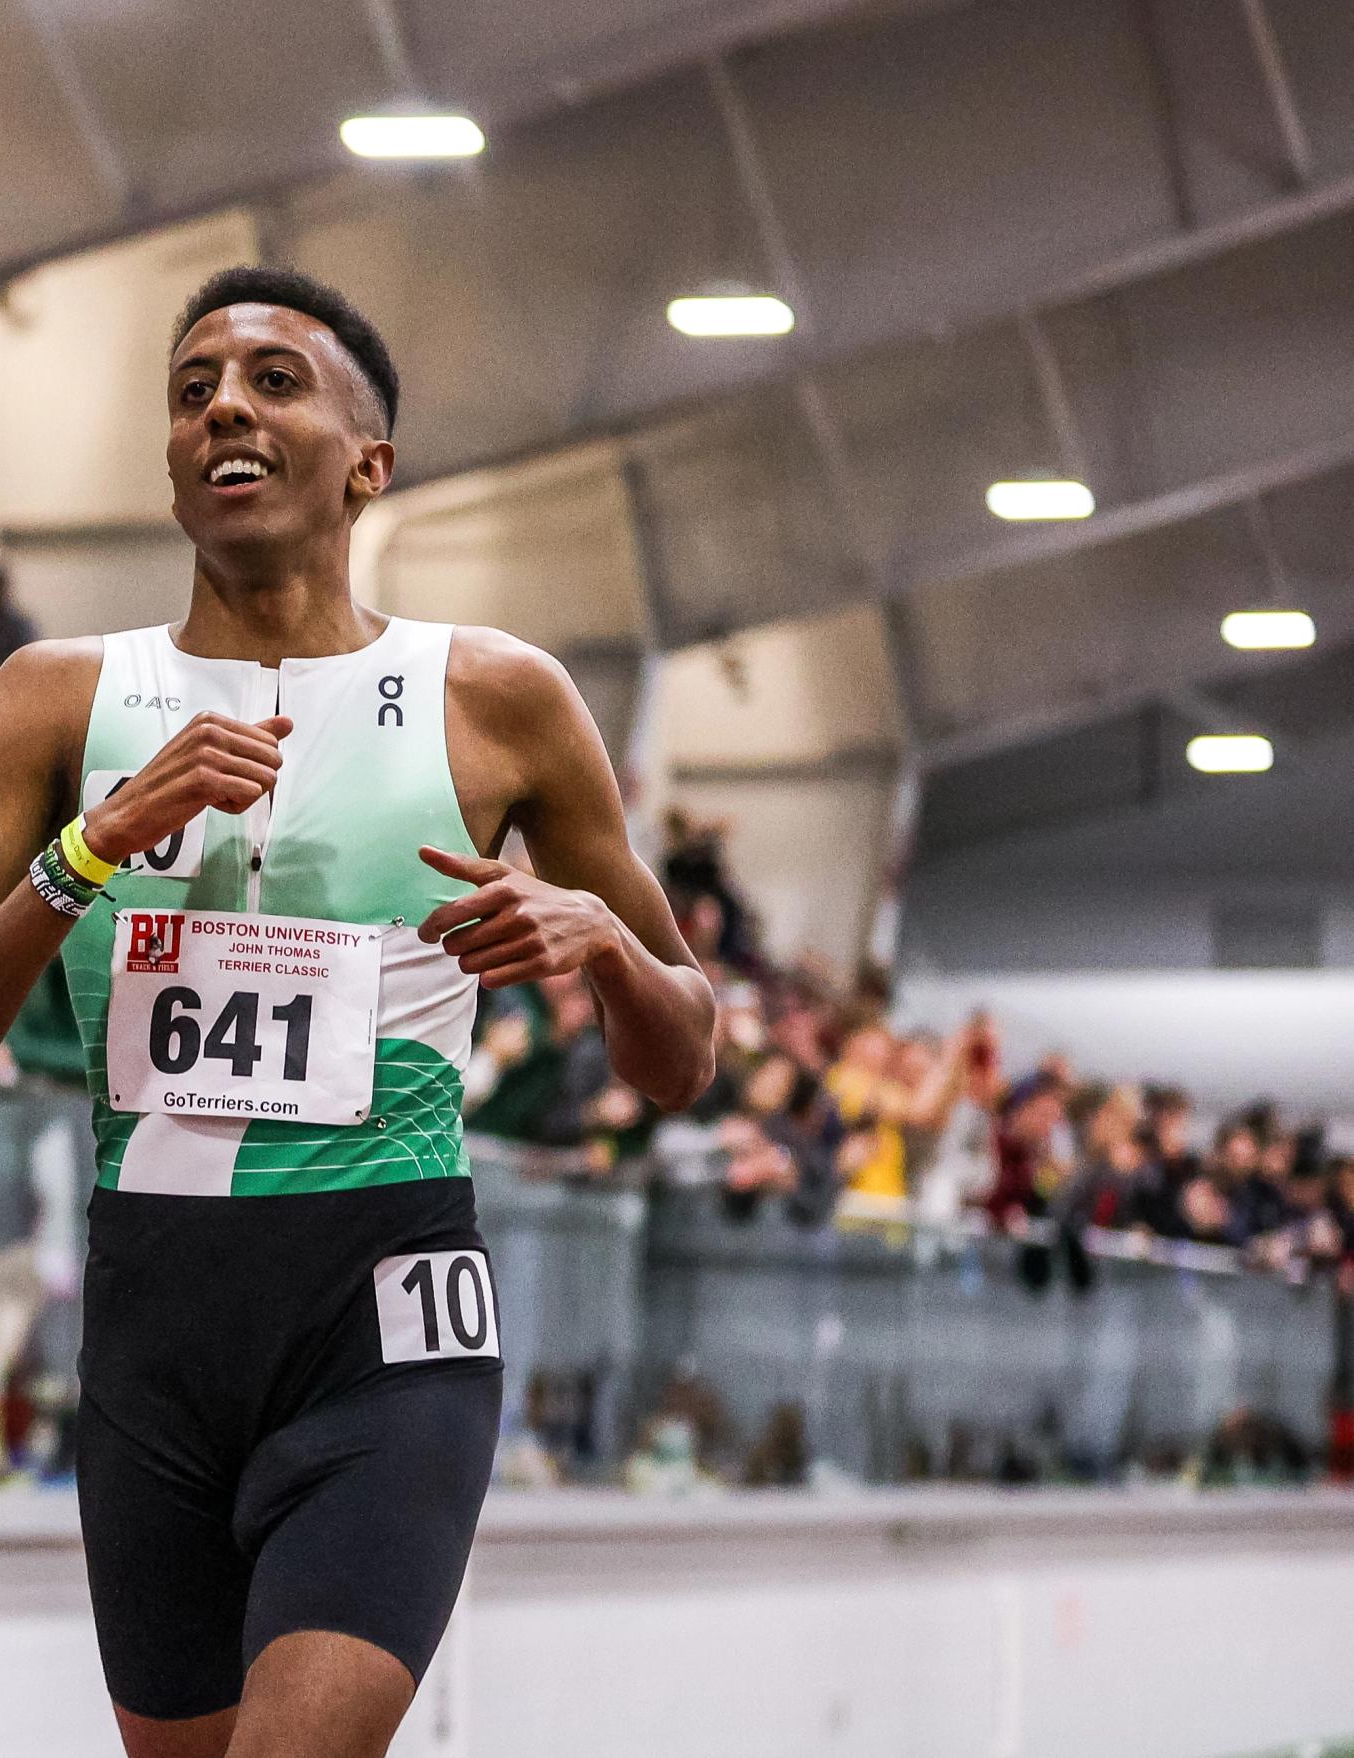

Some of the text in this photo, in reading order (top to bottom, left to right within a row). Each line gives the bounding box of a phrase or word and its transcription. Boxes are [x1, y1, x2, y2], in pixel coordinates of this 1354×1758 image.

[127, 914, 185, 962] BU
[192, 921, 361, 947] BOSTON UNIVERSITY
[229, 942, 321, 959] JOHN THOMAS
[218, 960, 330, 978] TERRIER CLASSIC
[149, 985, 313, 1082] 641
[163, 1091, 299, 1116] GoTerriers.com
[401, 1255, 488, 1353] 10
